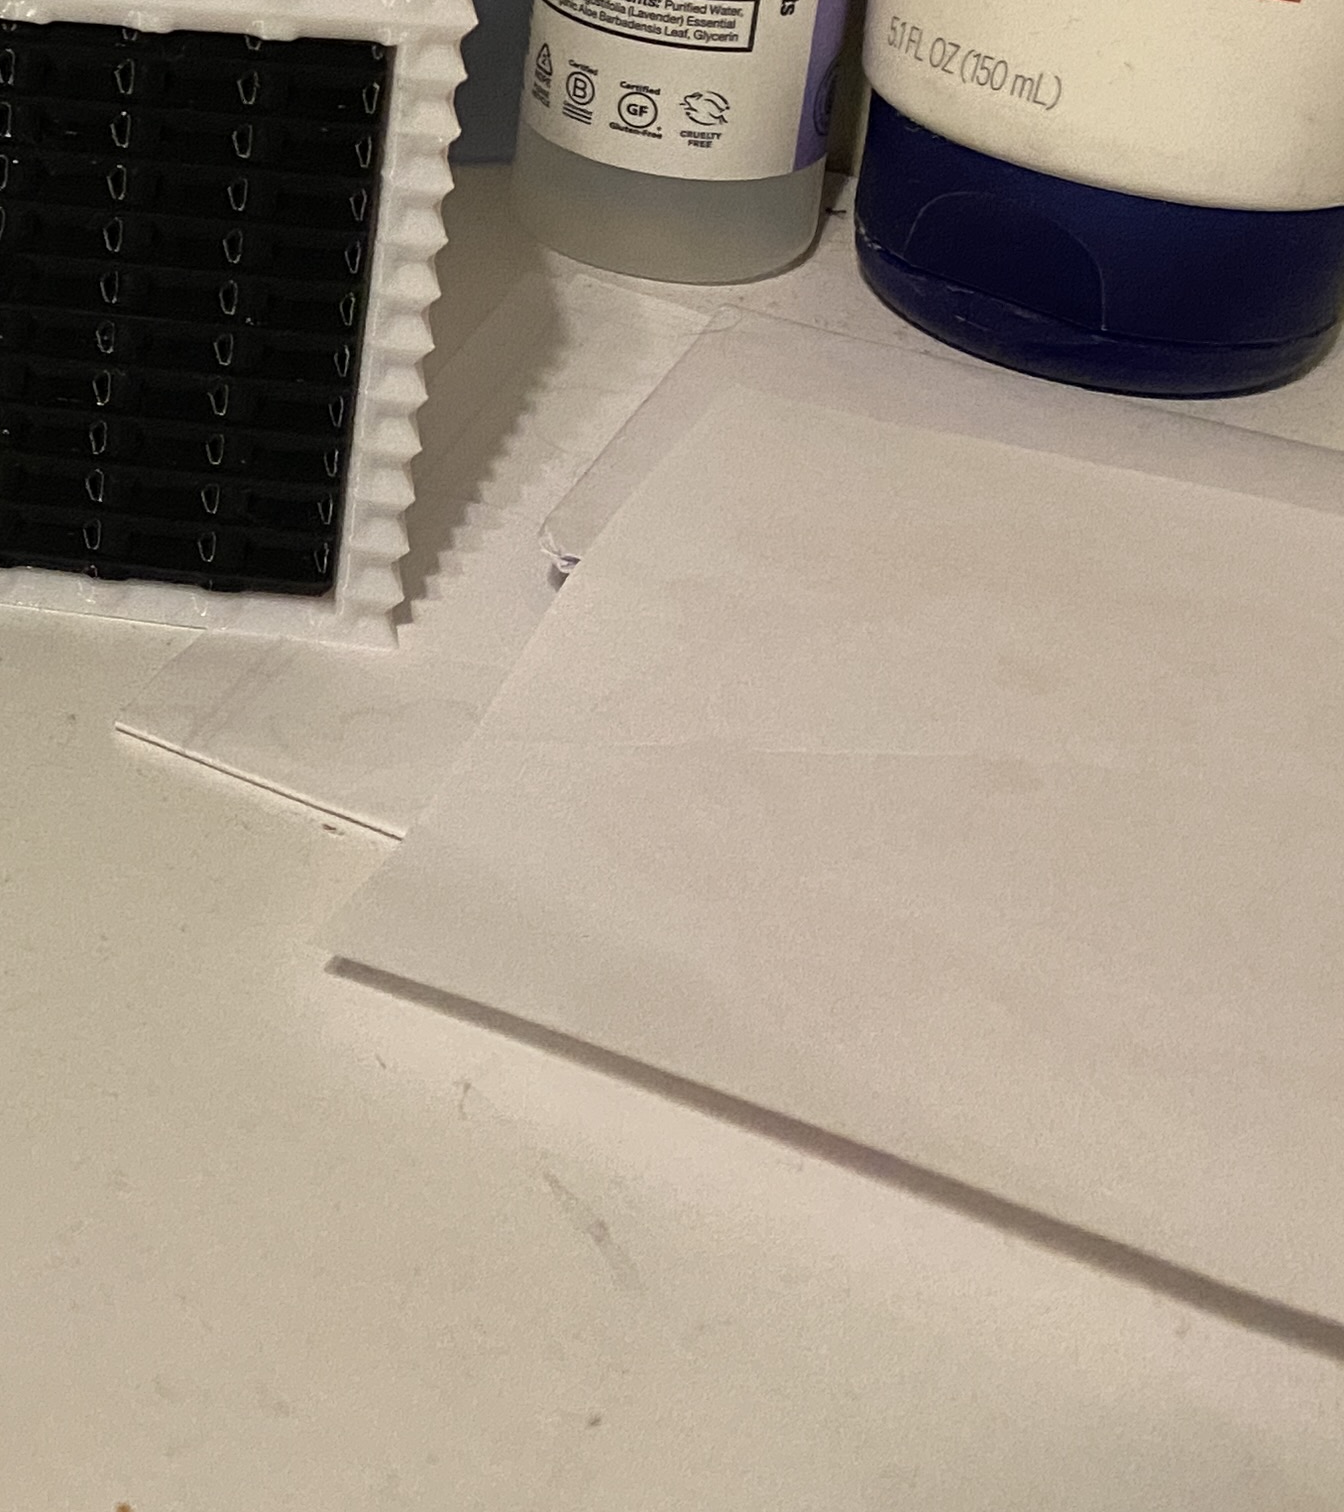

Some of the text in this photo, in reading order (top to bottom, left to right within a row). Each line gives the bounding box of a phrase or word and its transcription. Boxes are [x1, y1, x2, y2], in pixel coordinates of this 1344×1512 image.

[665, 0, 707, 14] Purified
[686, 15, 736, 29] Essential
[693, 30, 739, 43] Glycerin
[888, 15, 1062, 111] 5.1 FL OZ (150 mL)
[627, 103, 648, 117] GF
[680, 130, 722, 140] CRUELTY
[688, 140, 712, 148] FREE
